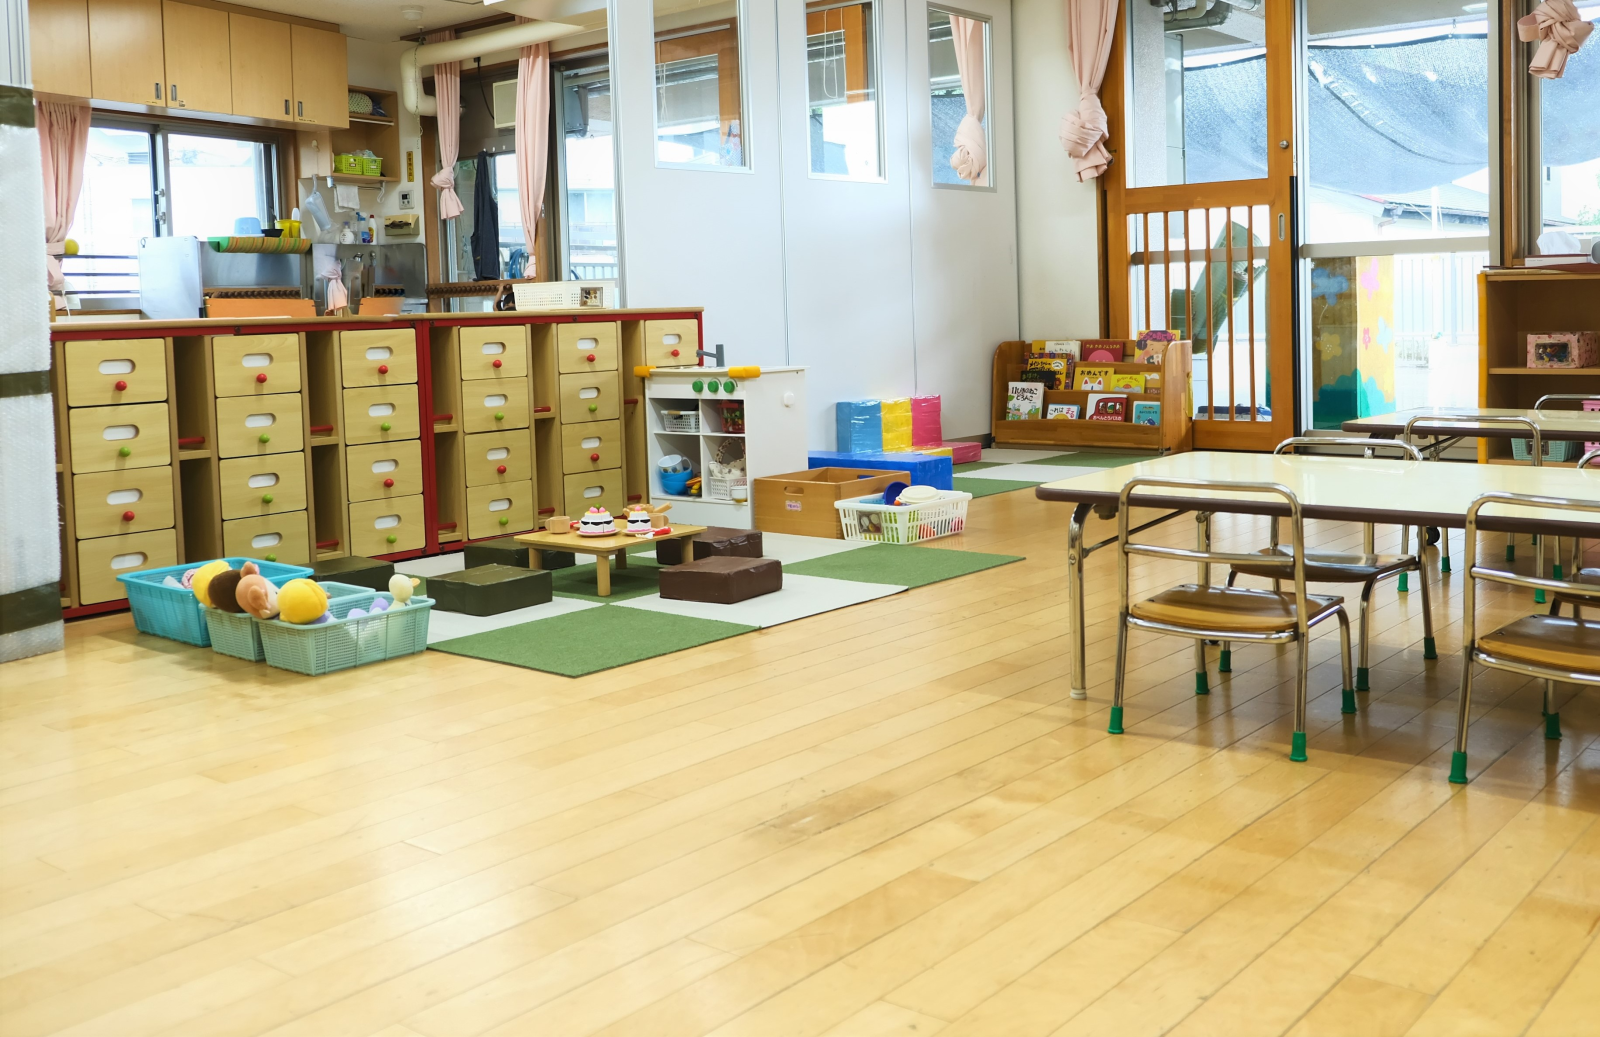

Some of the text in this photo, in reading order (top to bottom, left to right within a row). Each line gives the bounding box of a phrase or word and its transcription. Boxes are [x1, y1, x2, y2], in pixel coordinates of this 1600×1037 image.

[1011, 387, 1038, 395] 11ぴきのねこ
[1016, 394, 1034, 402] どろんこ
[1049, 407, 1075, 418] これは まる
